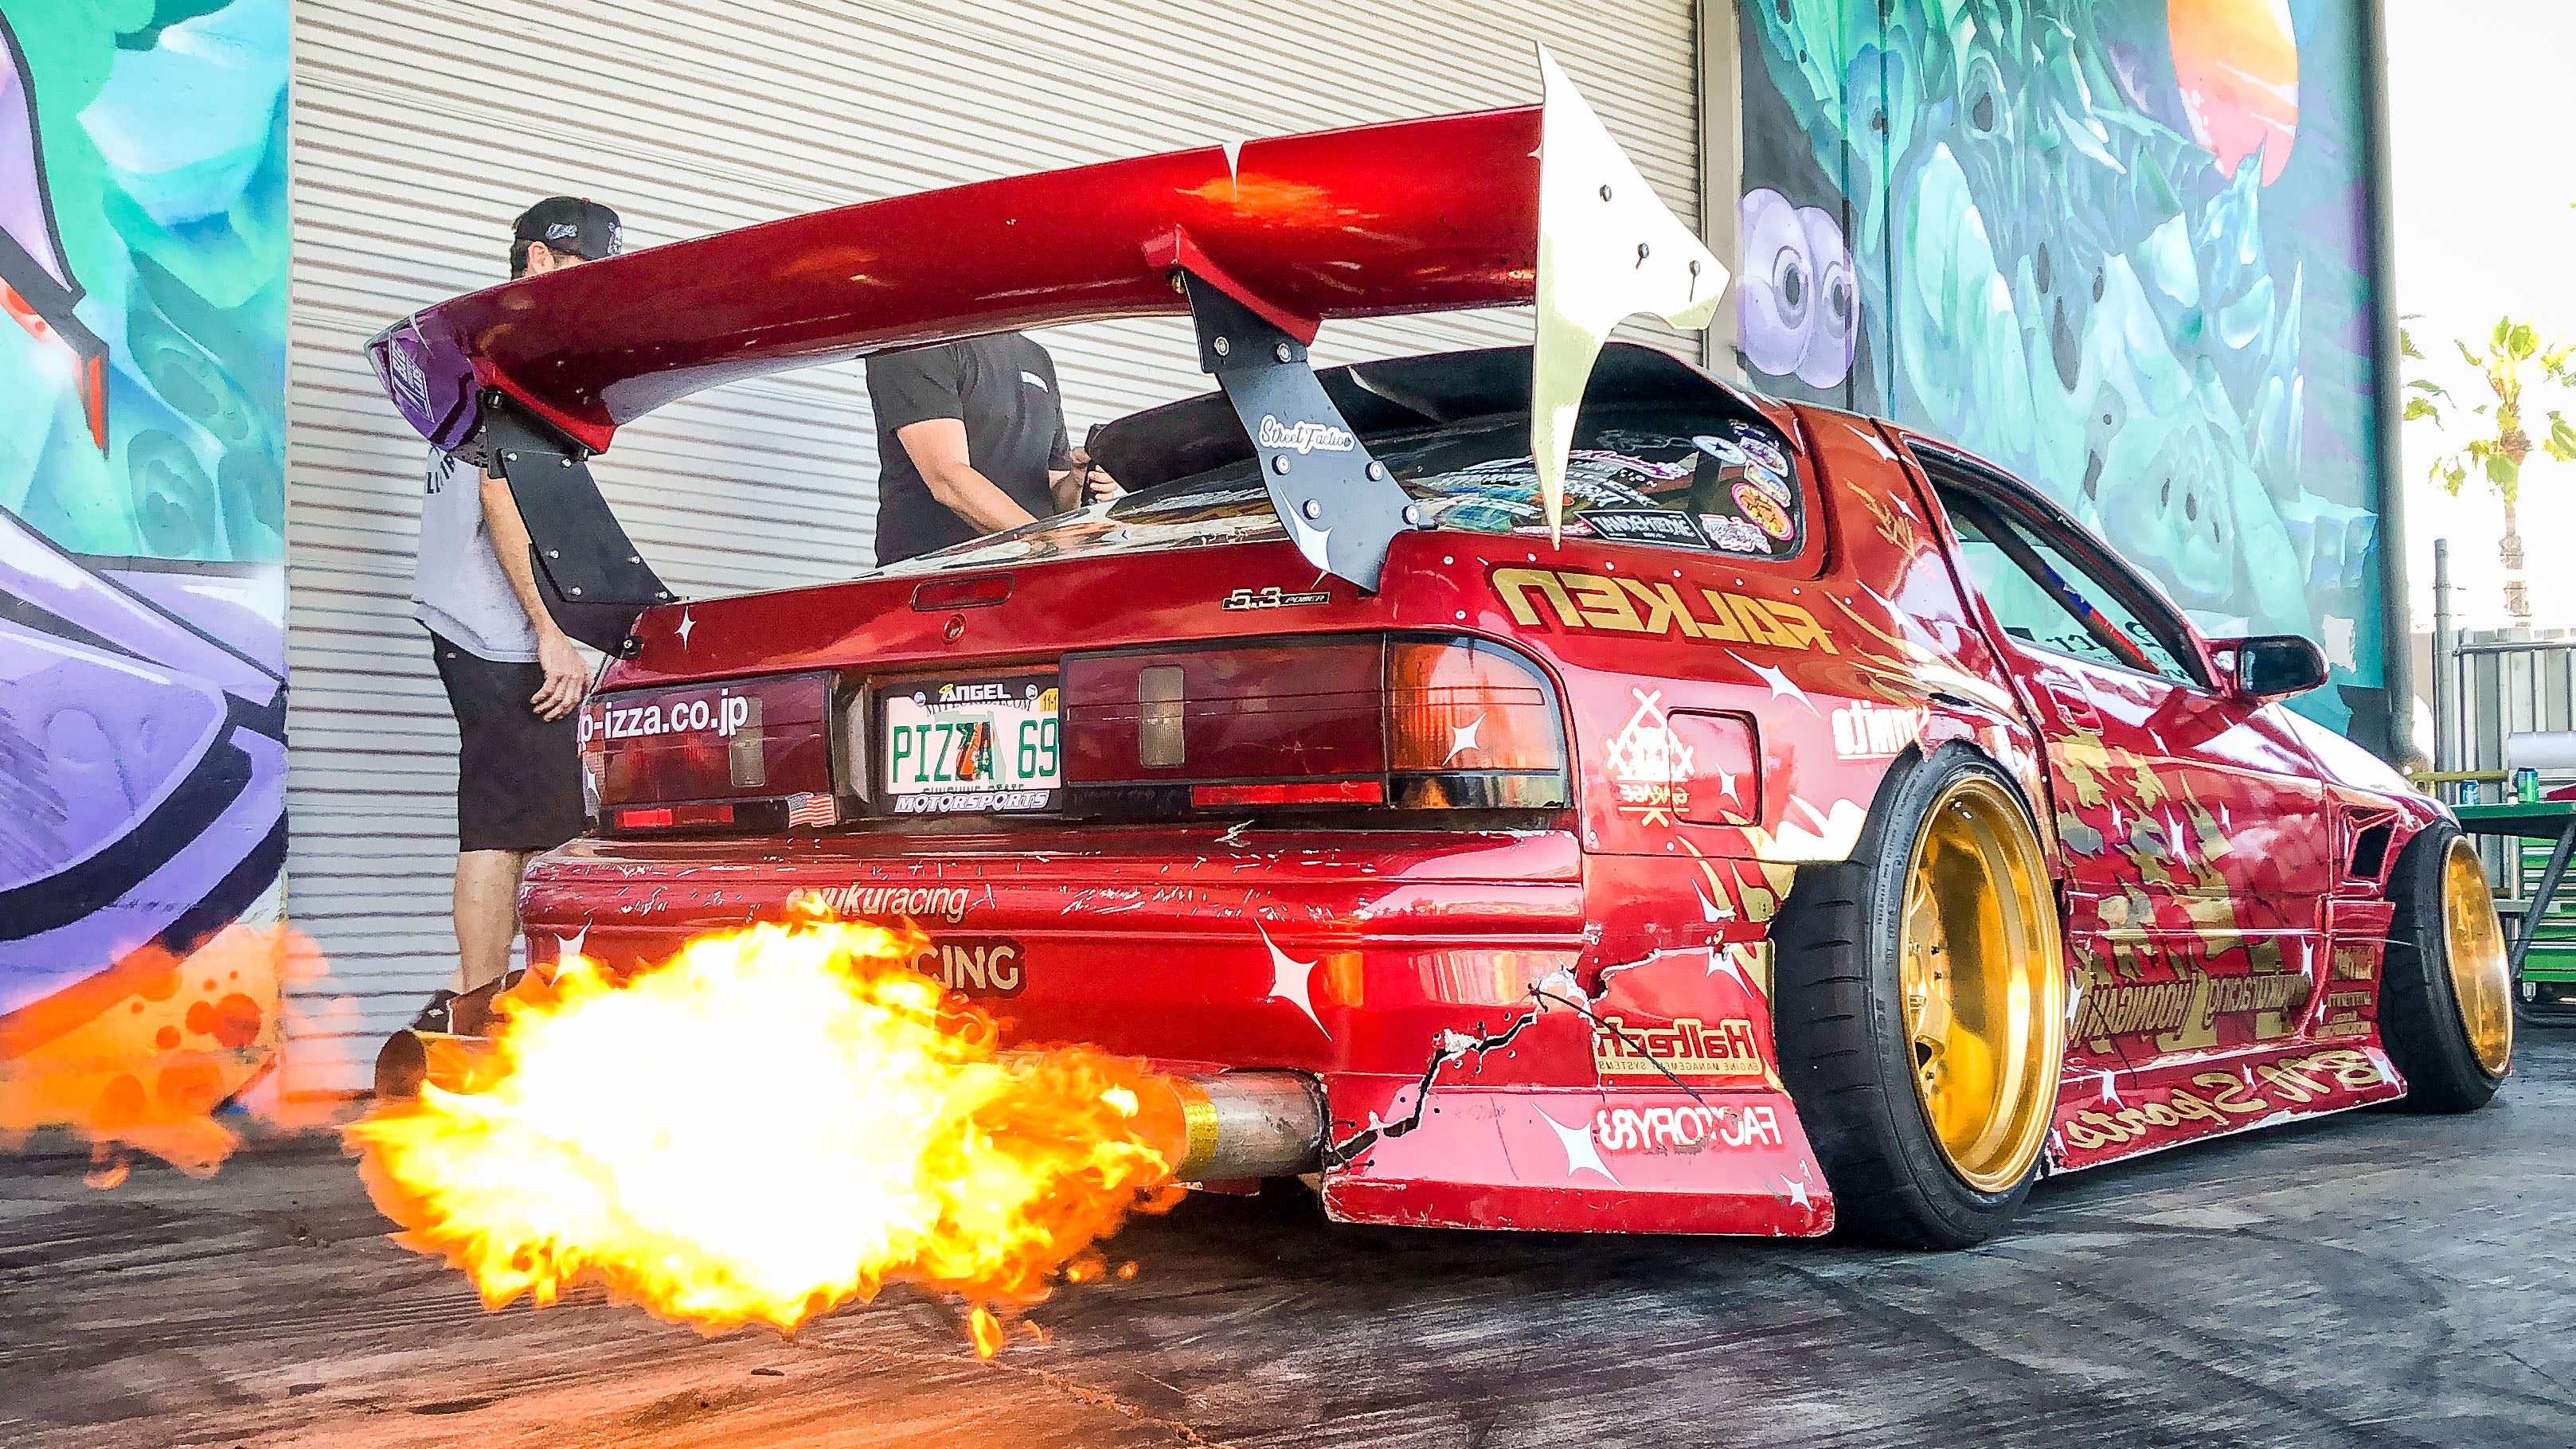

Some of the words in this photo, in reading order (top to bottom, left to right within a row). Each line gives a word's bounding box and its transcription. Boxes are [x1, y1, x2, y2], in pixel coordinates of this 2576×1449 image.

[1261, 417, 1304, 444] Street
[1229, 586, 1281, 609] 5.3
[939, 683, 1011, 702] ANGEL
[580, 687, 749, 751] p-izza.co.jp
[893, 721, 994, 783] PIZZA
[1018, 717, 1058, 779] 69
[893, 790, 1050, 813] MOTORSPORTS
